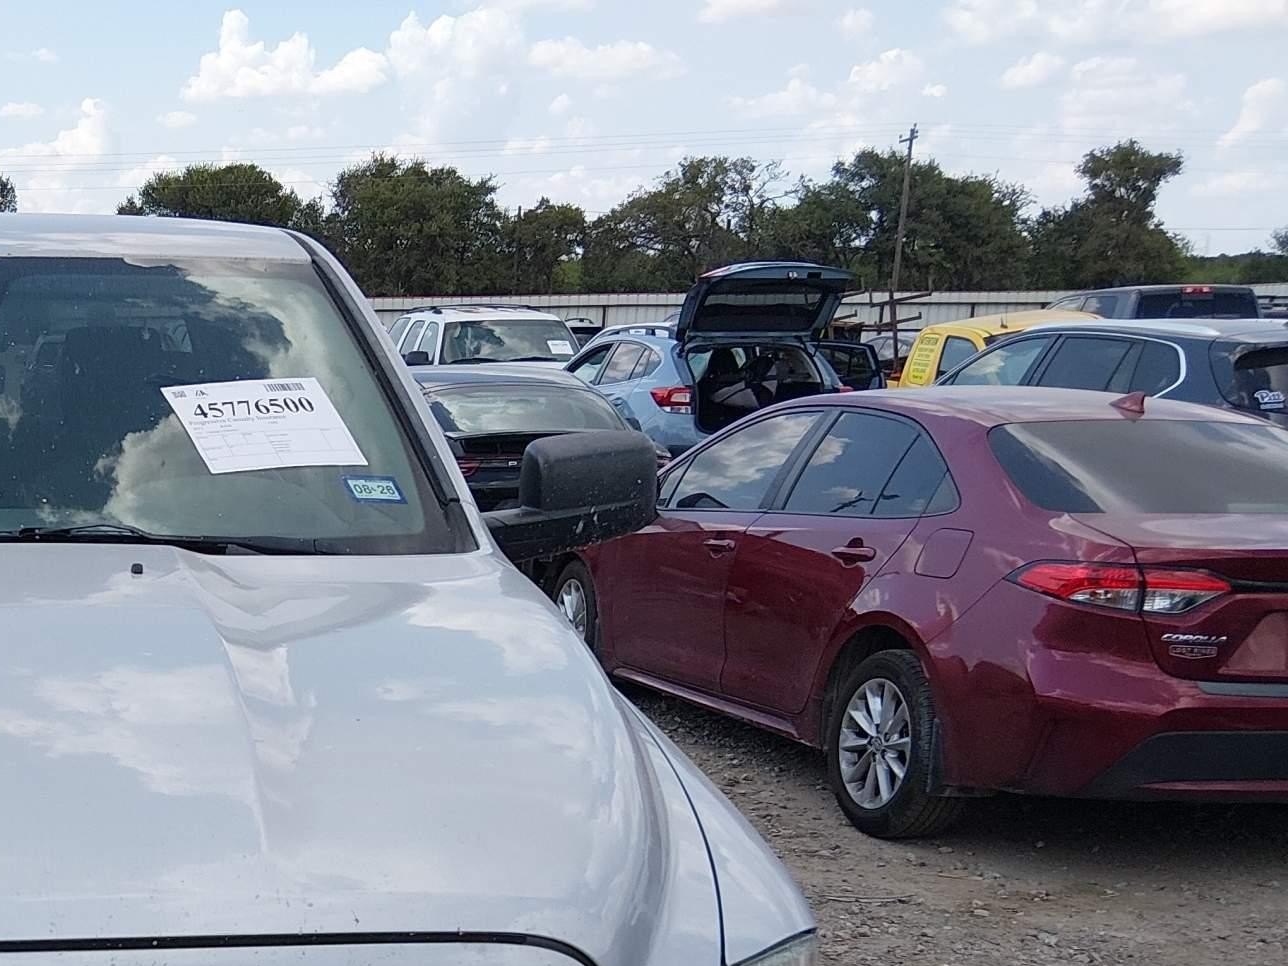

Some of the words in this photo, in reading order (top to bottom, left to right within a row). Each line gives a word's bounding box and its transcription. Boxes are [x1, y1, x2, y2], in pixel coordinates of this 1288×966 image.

[193, 396, 315, 419] 45776500
[353, 484, 372, 495] 08
[1160, 633, 1228, 643] COROLLA
